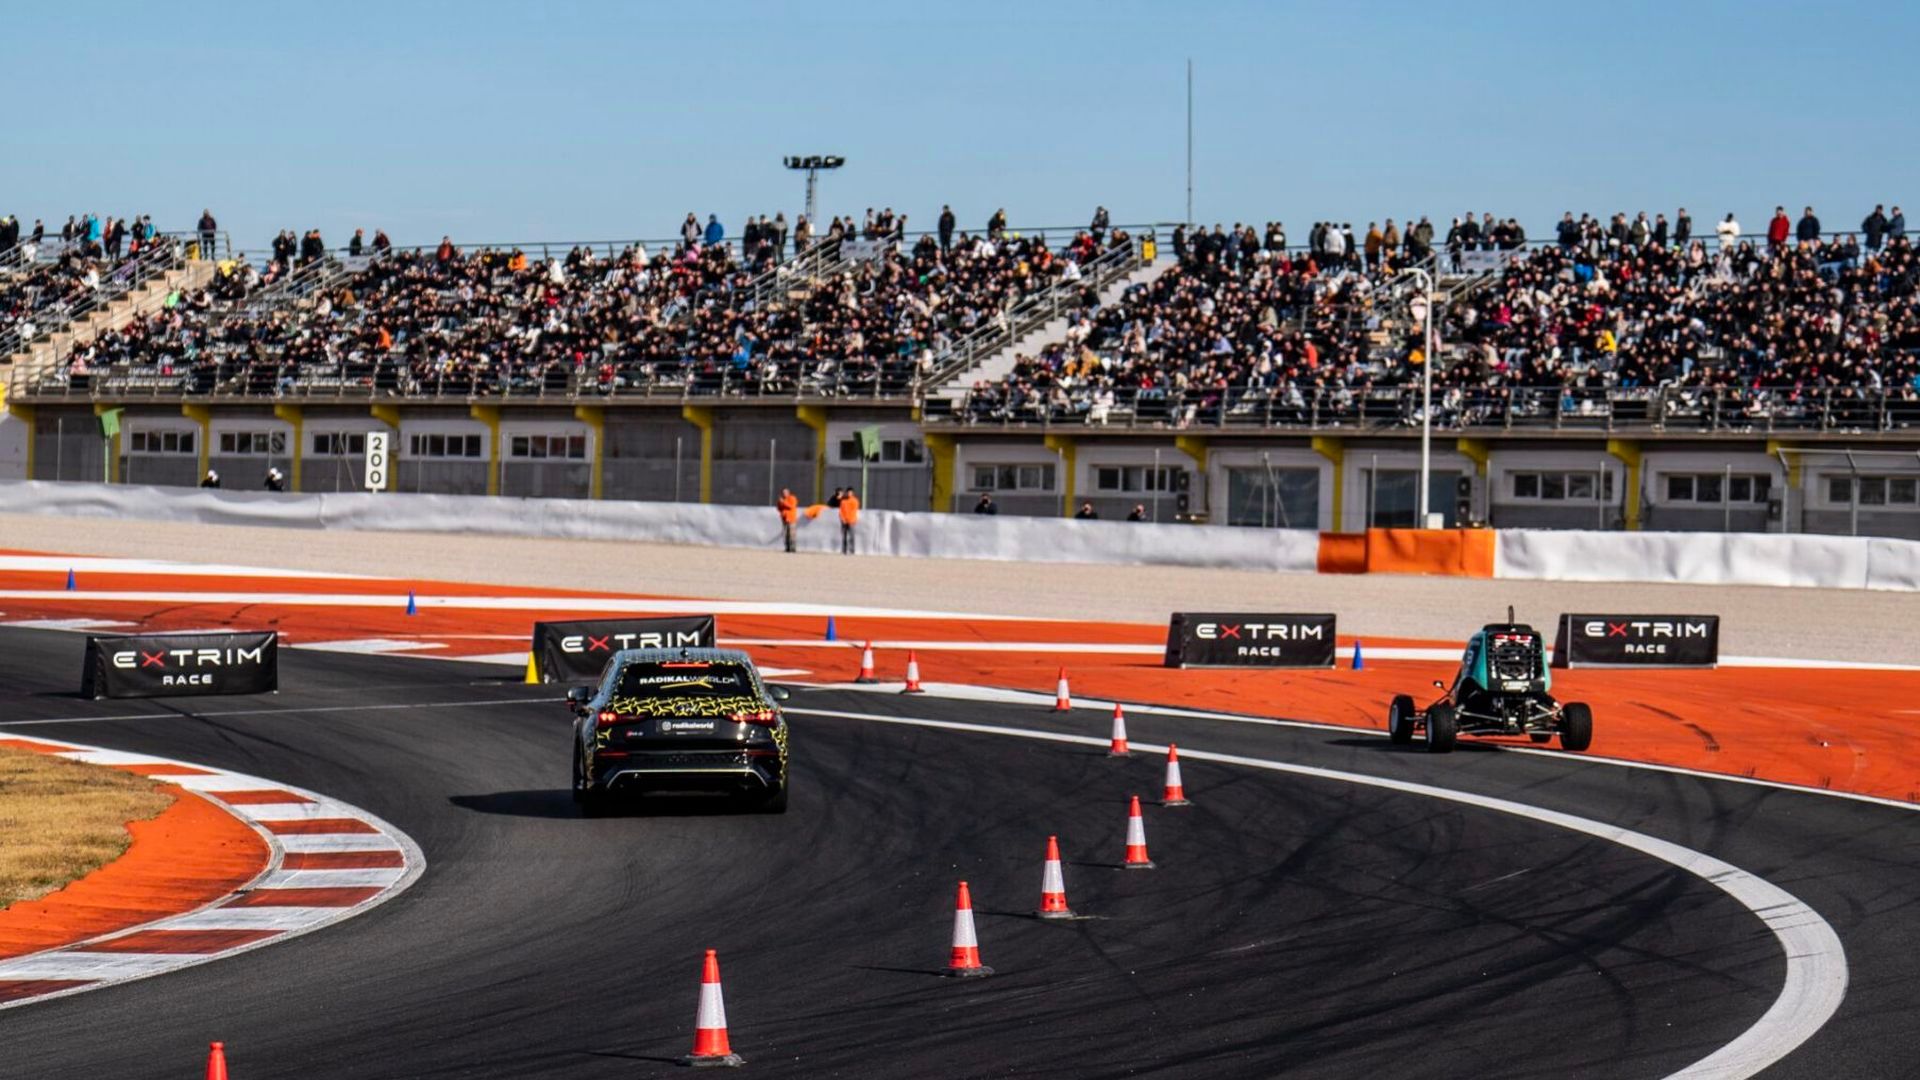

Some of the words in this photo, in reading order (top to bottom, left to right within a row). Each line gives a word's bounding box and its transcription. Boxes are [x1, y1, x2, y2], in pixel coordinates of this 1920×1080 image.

[370, 436, 382, 484] 200
[1196, 623, 1323, 640] EXTRIM
[1585, 622, 1706, 638] EXTRIM
[560, 630, 700, 653] EXTRIM
[1625, 644, 1666, 653] RACE
[113, 647, 262, 668] EXTRIM
[1238, 646, 1281, 656] RACE
[162, 674, 213, 685] RACE
